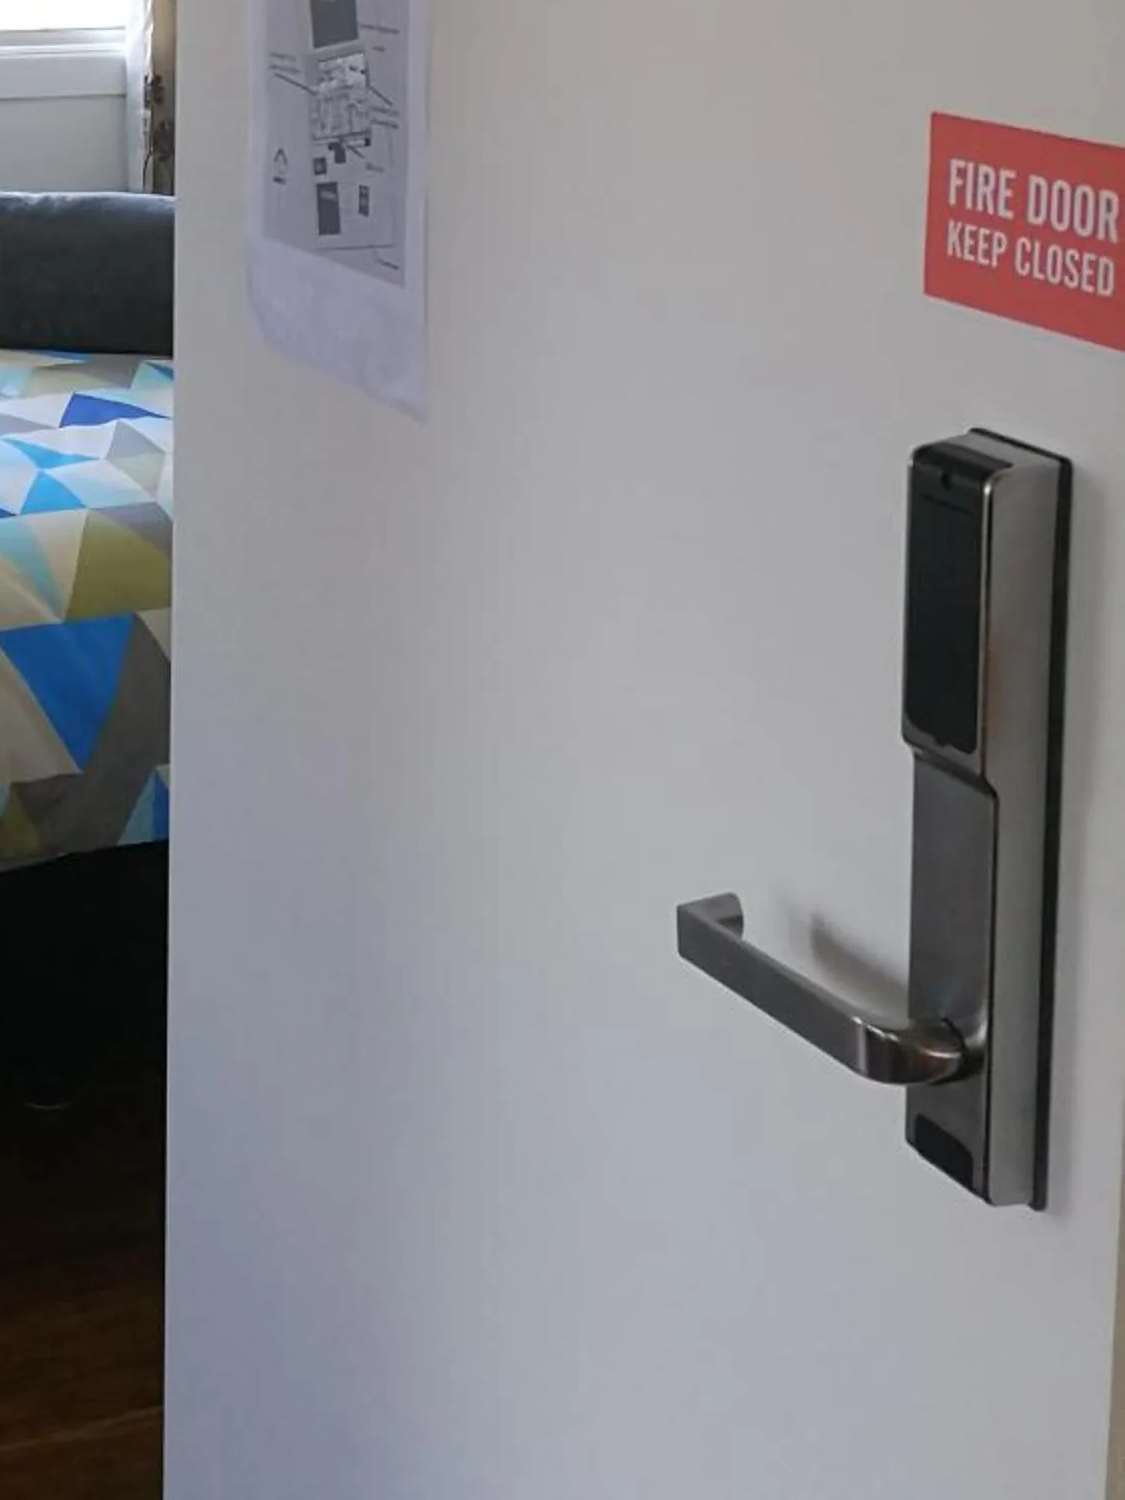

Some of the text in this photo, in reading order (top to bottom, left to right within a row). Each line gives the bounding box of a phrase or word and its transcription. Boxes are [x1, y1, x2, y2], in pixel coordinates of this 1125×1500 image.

[948, 158, 1120, 243] FIRE DOOR
[947, 220, 1116, 297] KEEP CLOSED
